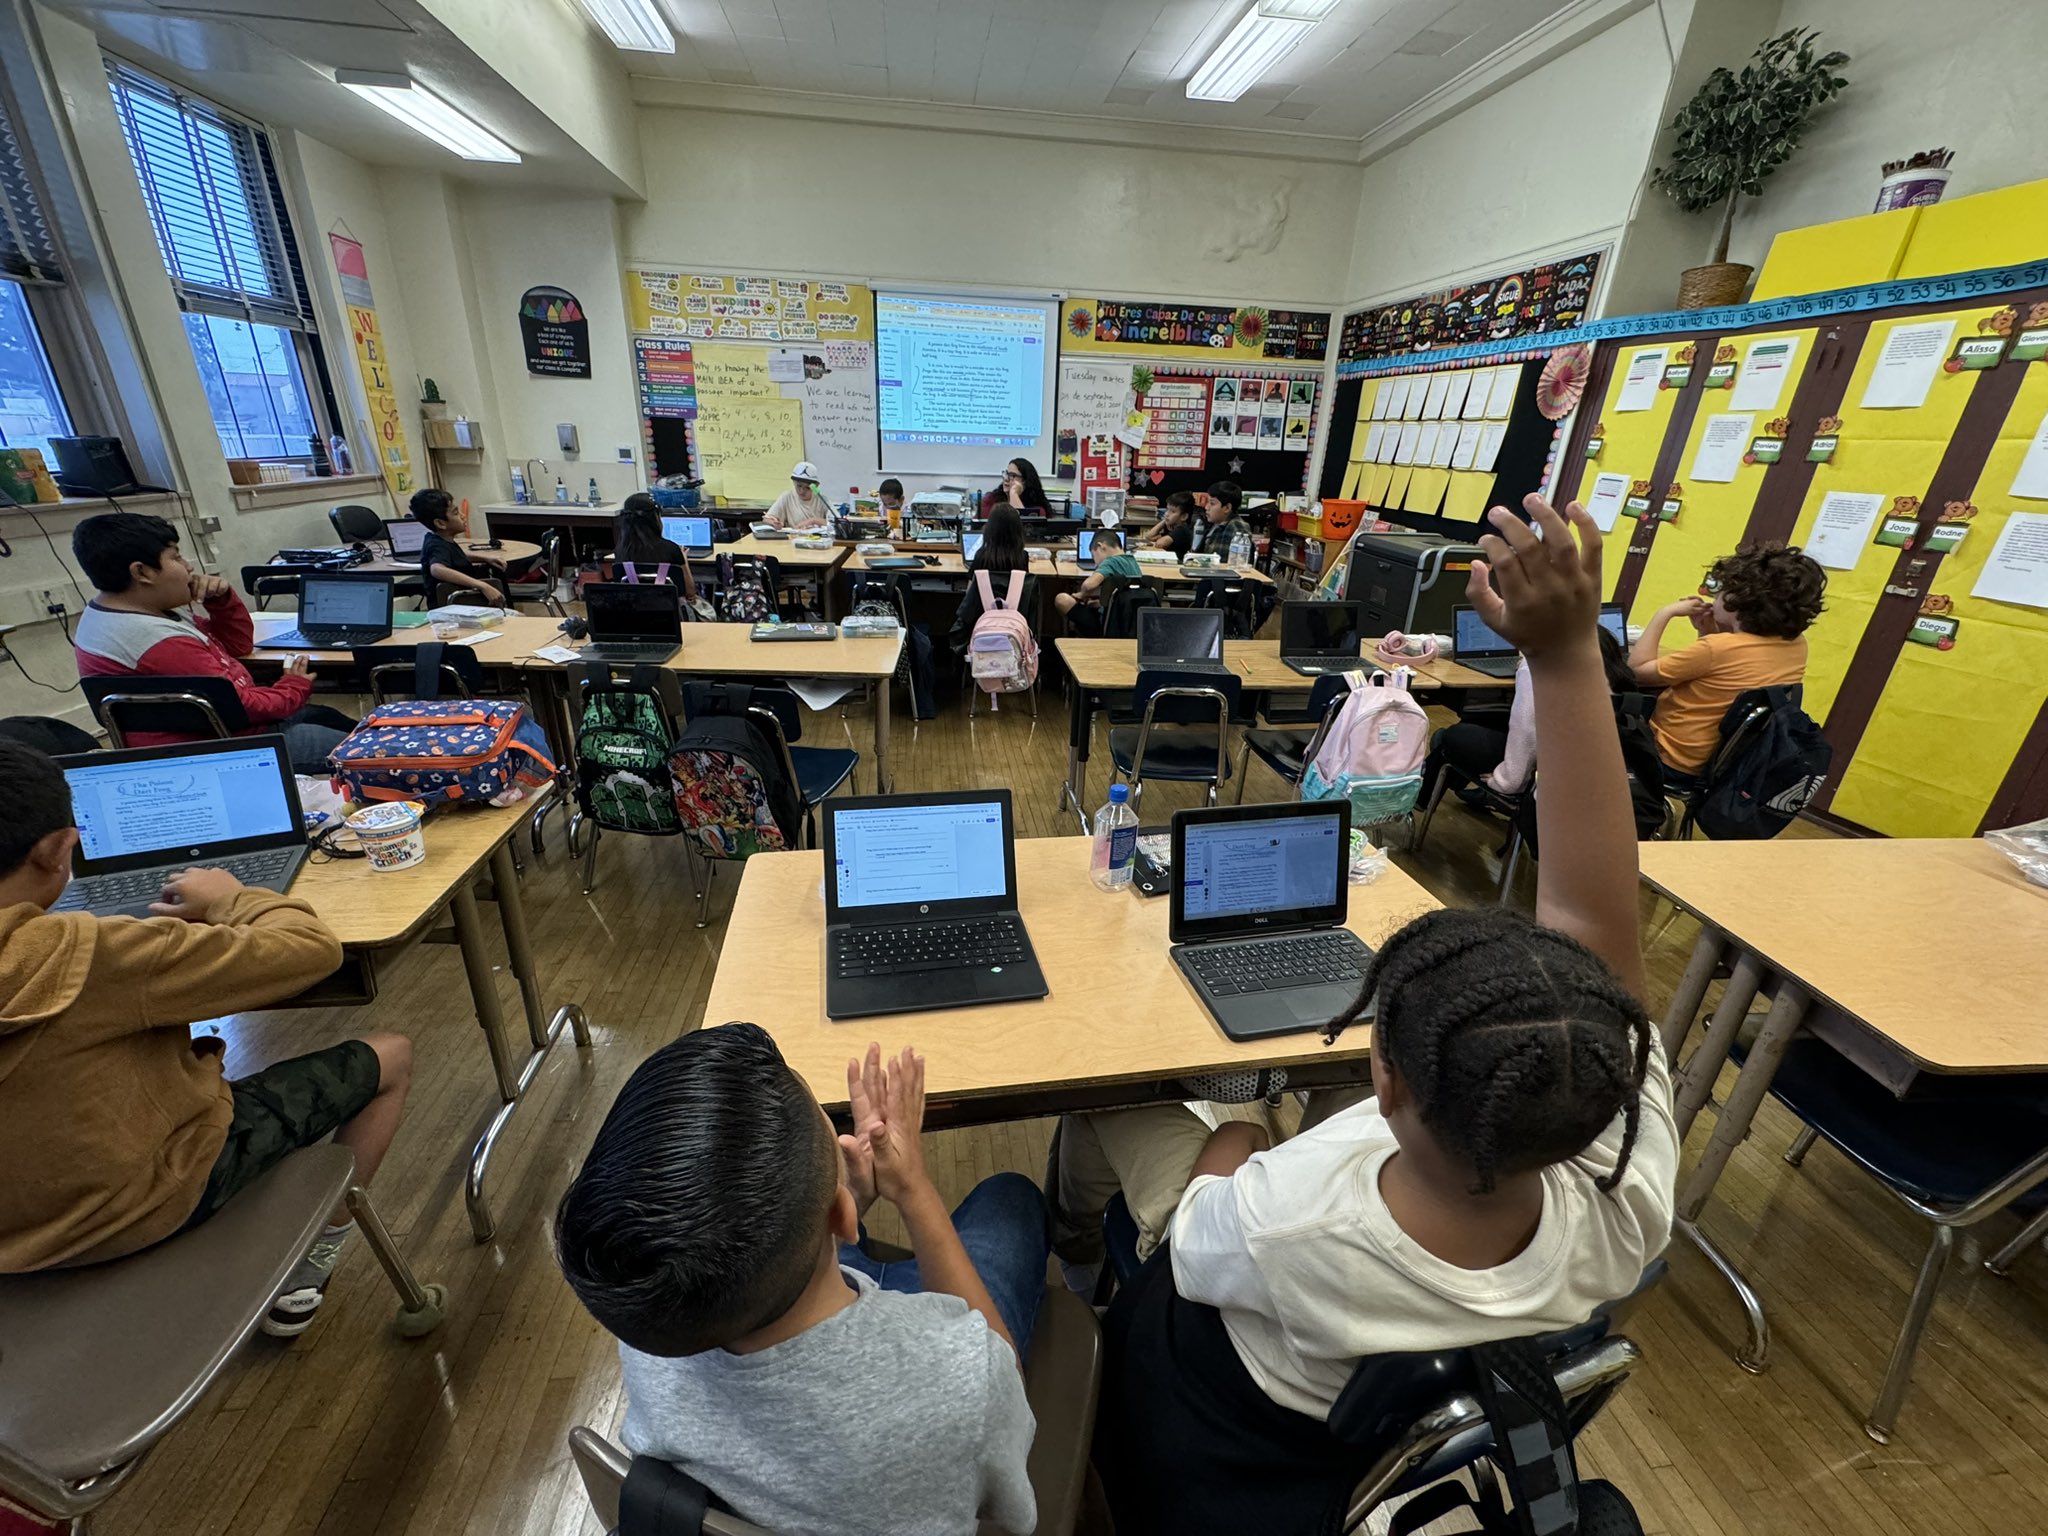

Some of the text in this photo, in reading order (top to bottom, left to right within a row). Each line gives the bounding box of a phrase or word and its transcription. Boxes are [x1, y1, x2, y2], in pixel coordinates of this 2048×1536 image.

[1496, 288, 1520, 303] SIGUE
[711, 296, 761, 308] KINDNESS
[1553, 294, 1585, 312] COSAS
[1592, 327, 1603, 337] 35
[1605, 325, 1617, 336] 36
[1619, 323, 1631, 334] 37
[1634, 322, 1645, 332] 38
[1648, 320, 1659, 331] 39
[1662, 318, 1674, 330] 40
[1678, 317, 1687, 328] 41
[1691, 317, 1702, 328] 42
[1707, 314, 1719, 326] 43
[1722, 313, 1735, 324] 44
[1740, 311, 1754, 323] 45
[1758, 308, 1772, 320] 46
[1777, 304, 1790, 318] 47
[1797, 302, 1812, 315] 48
[1818, 298, 1833, 310] 49
[1838, 295, 1856, 308] 50
[1865, 292, 1879, 305] 51
[1887, 289, 1905, 301] 52
[1911, 286, 1930, 299] 53
[1936, 284, 1957, 298] 54
[1965, 278, 1986, 293] 55
[1992, 274, 2015, 289] 56
[2024, 267, 2048, 284] 57
[1104, 305, 1228, 324] Tú Eres Capaz De Cosas
[636, 340, 691, 351] Class Rules
[1964, 345, 1997, 353] Alissa
[714, 364, 721, 372] is
[754, 364, 766, 373] the
[1712, 368, 1730, 376] Scott
[718, 376, 734, 385] IDEA
[737, 377, 746, 387] of
[1064, 368, 1097, 384] Tuesday
[806, 384, 822, 397] We
[825, 389, 840, 397] are
[354, 309, 408, 492] WELCOME
[809, 400, 845, 410] to read
[1754, 441, 1778, 450] Daniela
[1889, 522, 1911, 533] Joan
[1919, 620, 1947, 632] Diego
[603, 744, 647, 755] MINECRAFT
[366, 839, 409, 854] Cinnamon
[373, 850, 412, 868] Crunch
